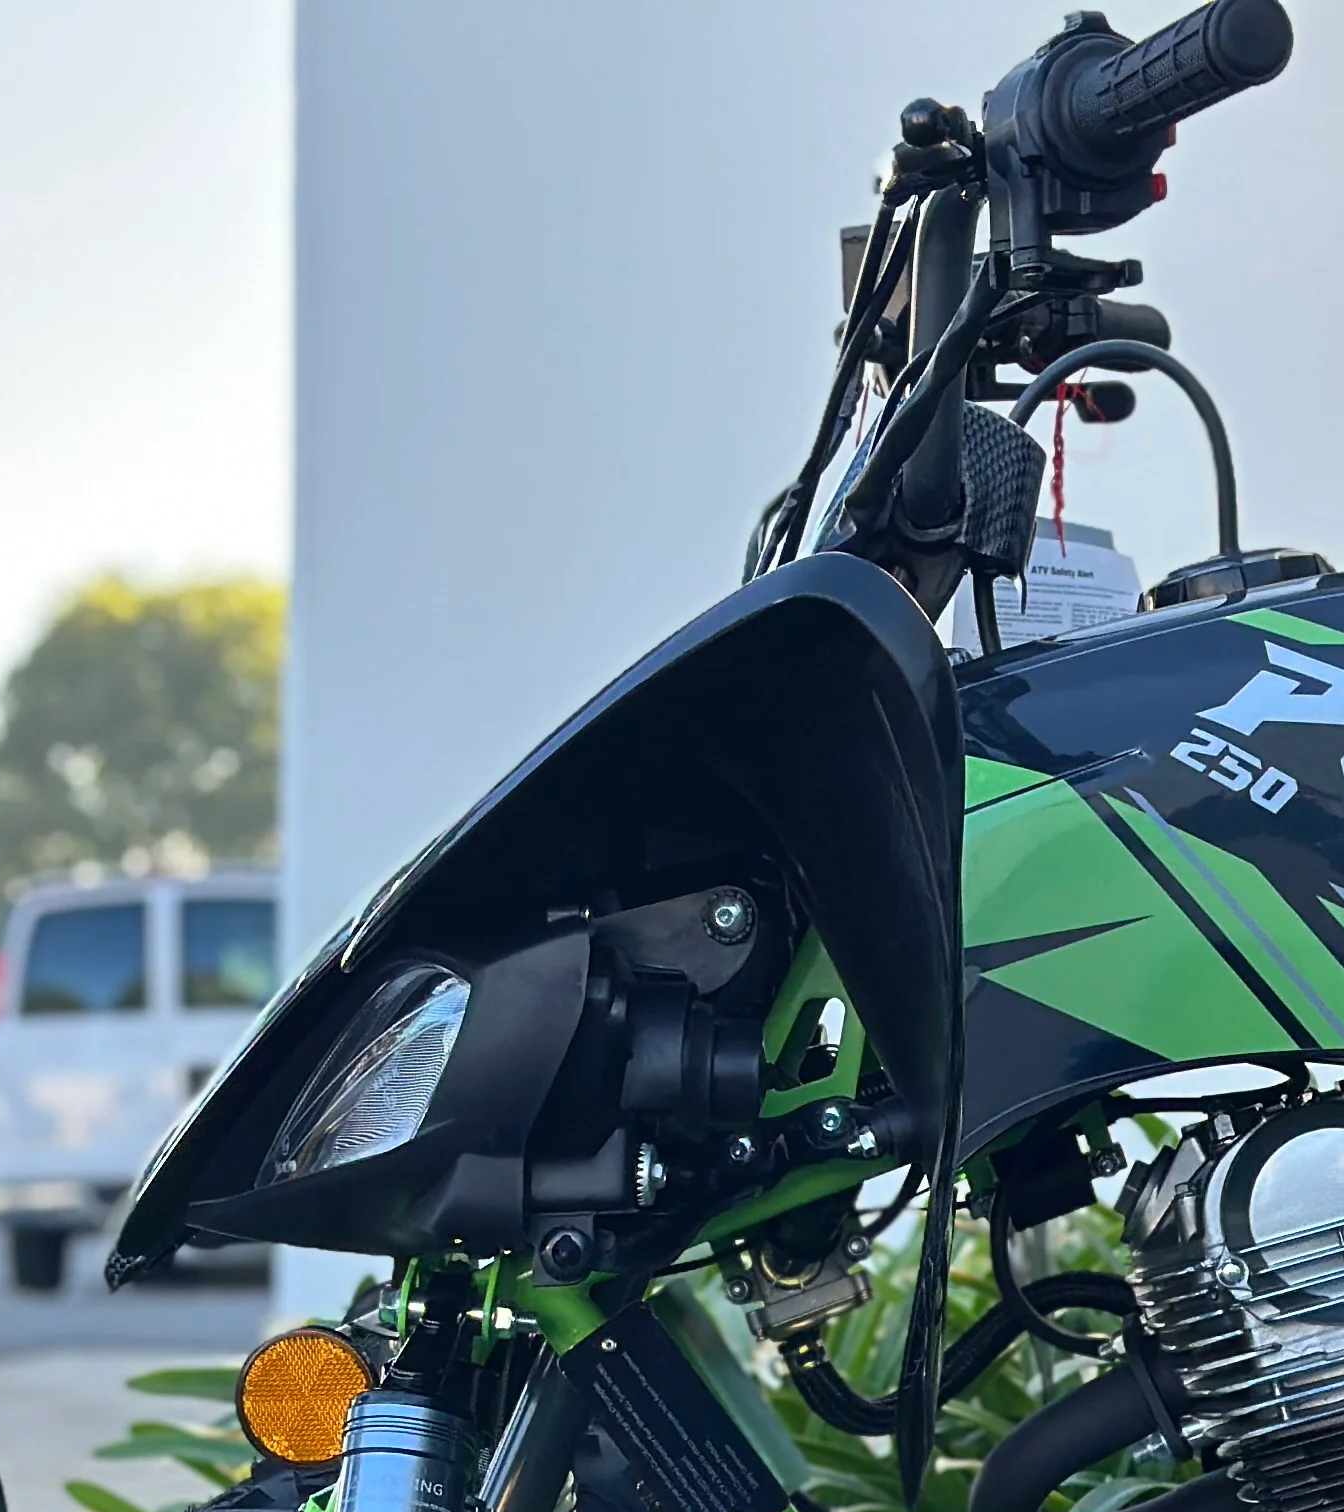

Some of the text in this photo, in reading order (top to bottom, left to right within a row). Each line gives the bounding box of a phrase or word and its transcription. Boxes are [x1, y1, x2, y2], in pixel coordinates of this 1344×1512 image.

[1031, 565, 1095, 579] ATV Safety Alert
[1169, 728, 1299, 814] 250
